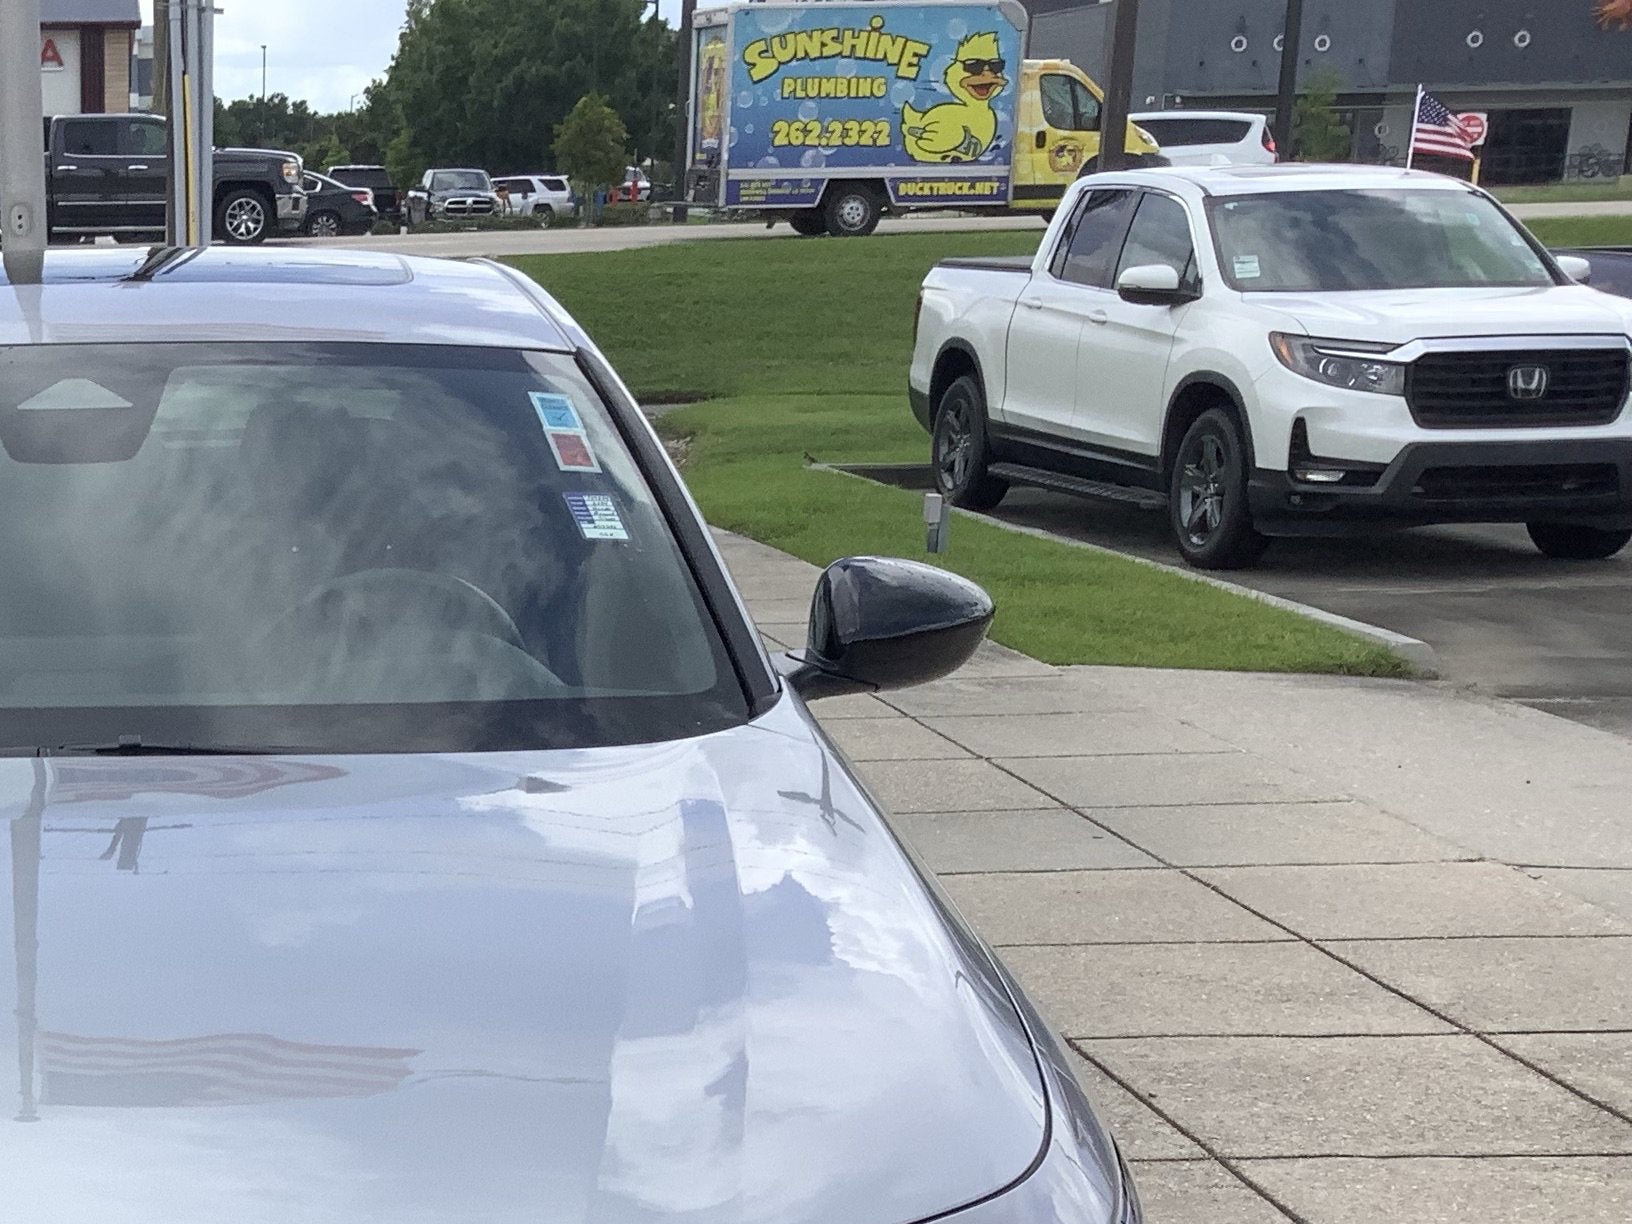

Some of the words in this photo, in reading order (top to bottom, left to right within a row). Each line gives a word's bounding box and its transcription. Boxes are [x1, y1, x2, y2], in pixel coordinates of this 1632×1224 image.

[781, 77, 887, 99] PLUMBING
[772, 119, 891, 147] 262.2322
[898, 181, 1000, 195] DUCKTRUCK.NET
